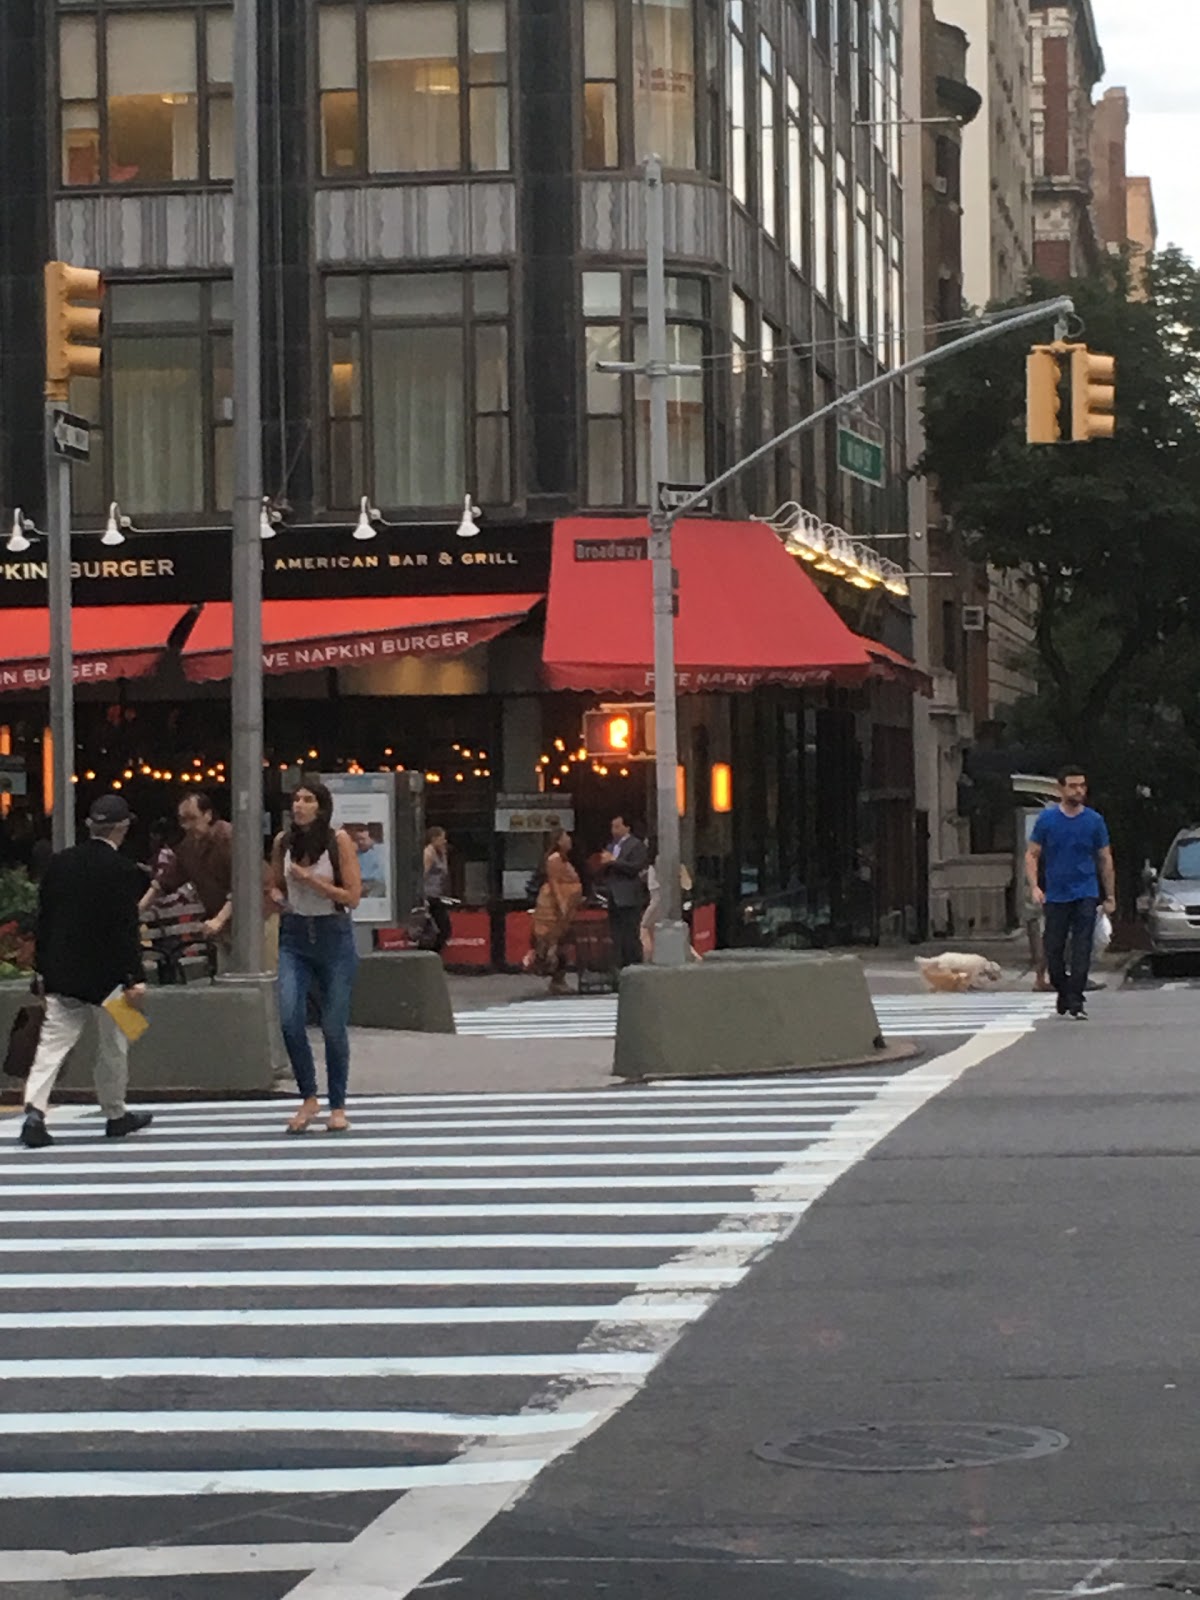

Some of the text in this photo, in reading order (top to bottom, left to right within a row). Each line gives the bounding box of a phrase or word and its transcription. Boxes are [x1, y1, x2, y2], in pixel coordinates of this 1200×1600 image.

[576, 541, 642, 560] Broadway
[0, 559, 175, 581] KIN BURGER
[274, 552, 519, 571] AMERICAN BAR & GRILL
[263, 631, 470, 668] VE NAPKIN BURGER
[23, 662, 108, 684] BUGER
[644, 671, 691, 687] FE
